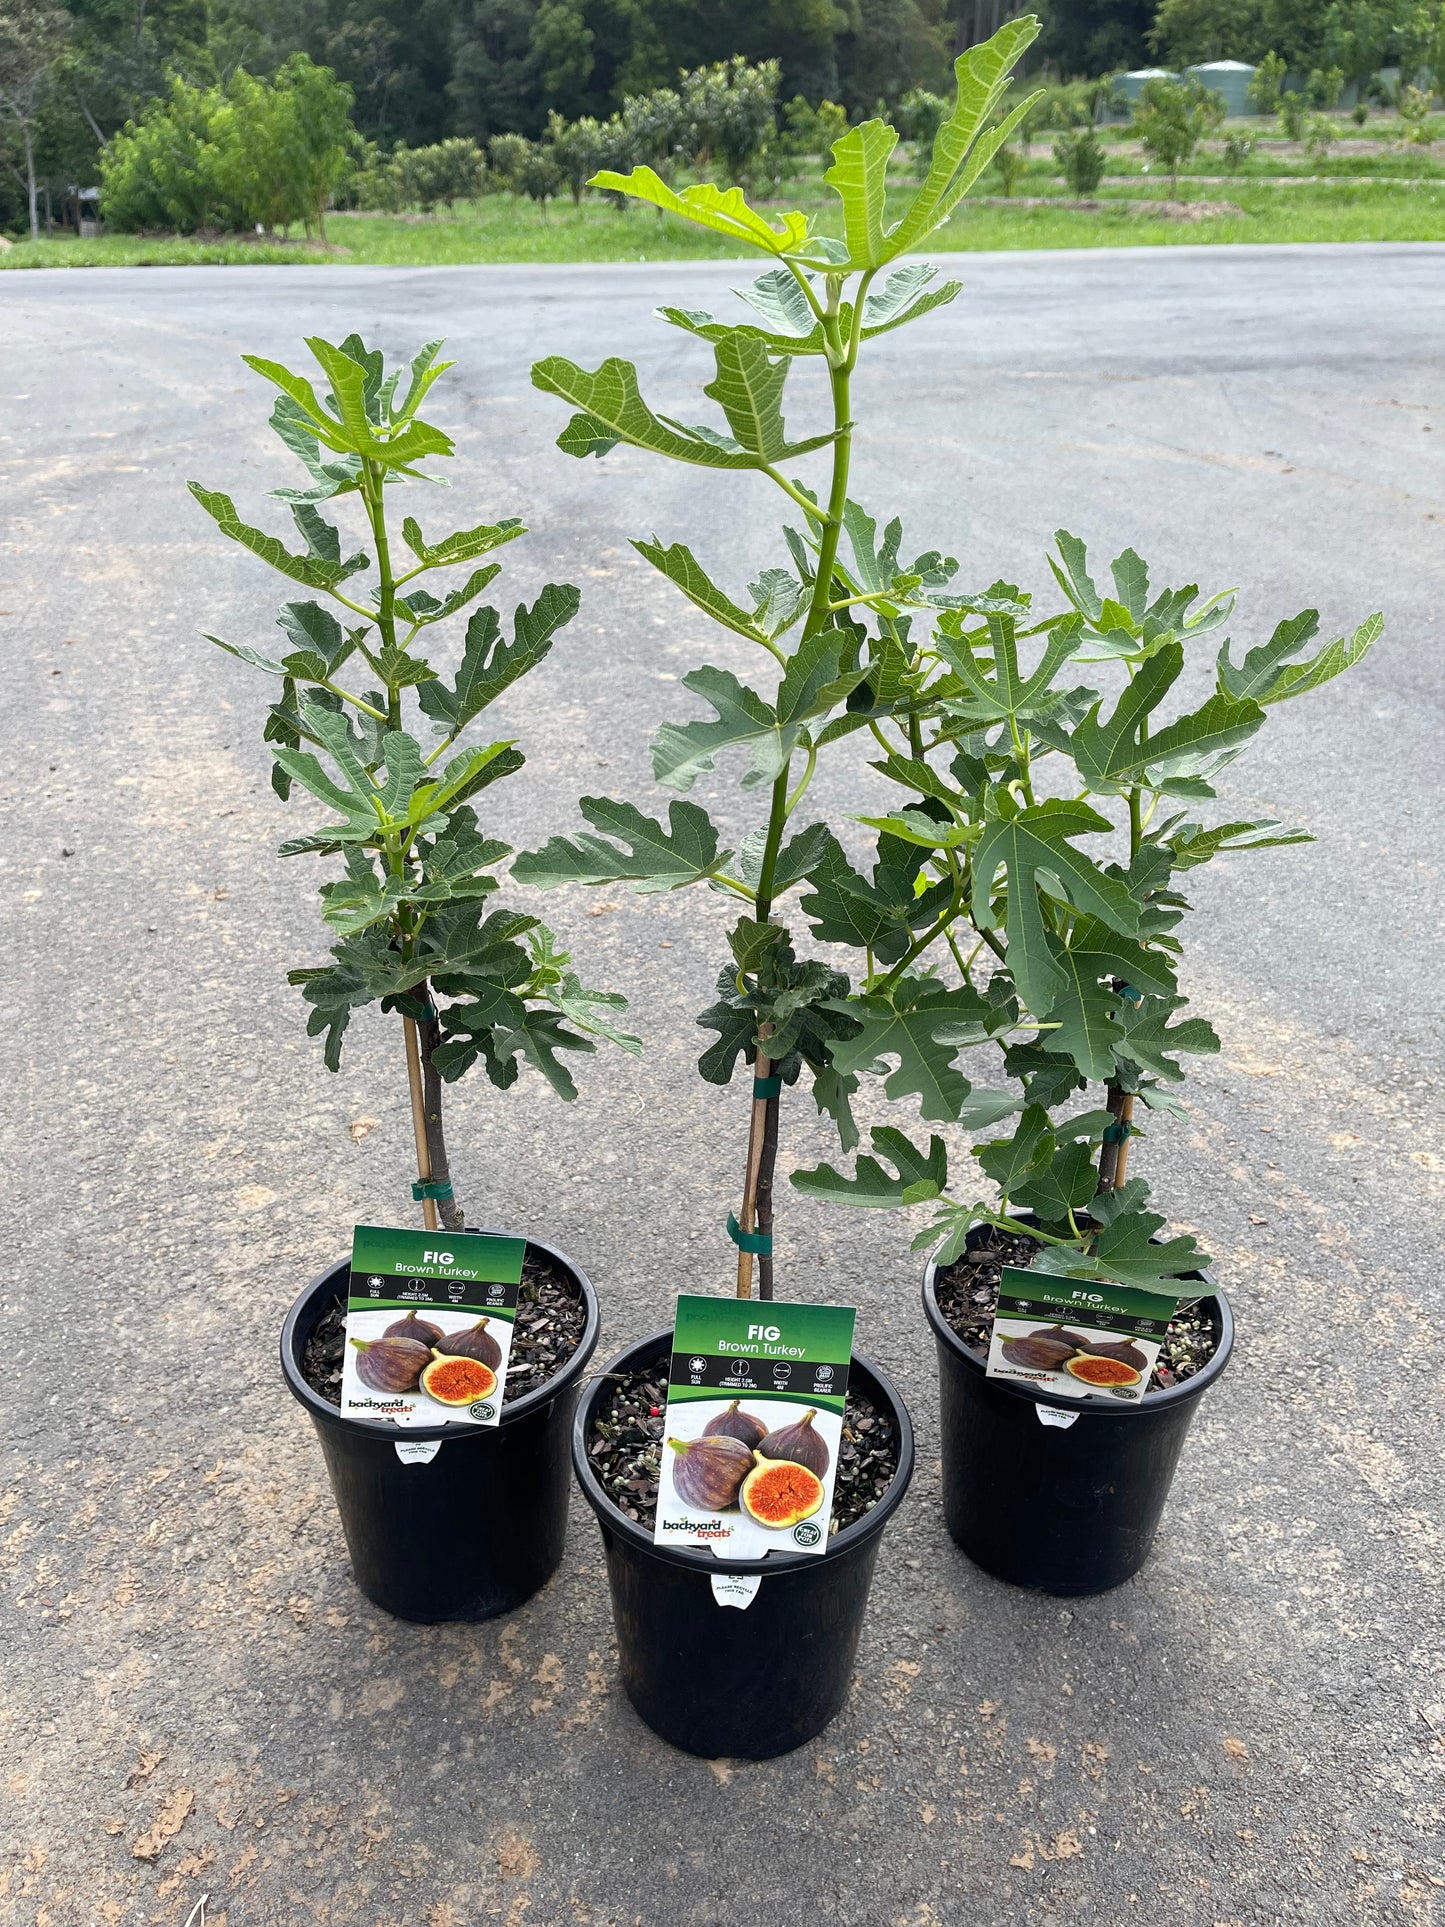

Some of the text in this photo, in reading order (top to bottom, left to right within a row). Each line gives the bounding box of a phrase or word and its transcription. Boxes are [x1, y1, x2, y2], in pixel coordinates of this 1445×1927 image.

[423, 1250, 455, 1265] FIG
[395, 1262, 479, 1279] Brown Turkey
[1071, 1290, 1104, 1302] FIG
[1043, 1294, 1129, 1314] Brown Turkey
[747, 1324, 781, 1342] FIG
[718, 1339, 806, 1359] Brown Turkey
[348, 1399, 404, 1410] backyard
[381, 1406, 413, 1414] treats
[662, 1518, 722, 1532] backyard
[697, 1528, 731, 1538] treats
